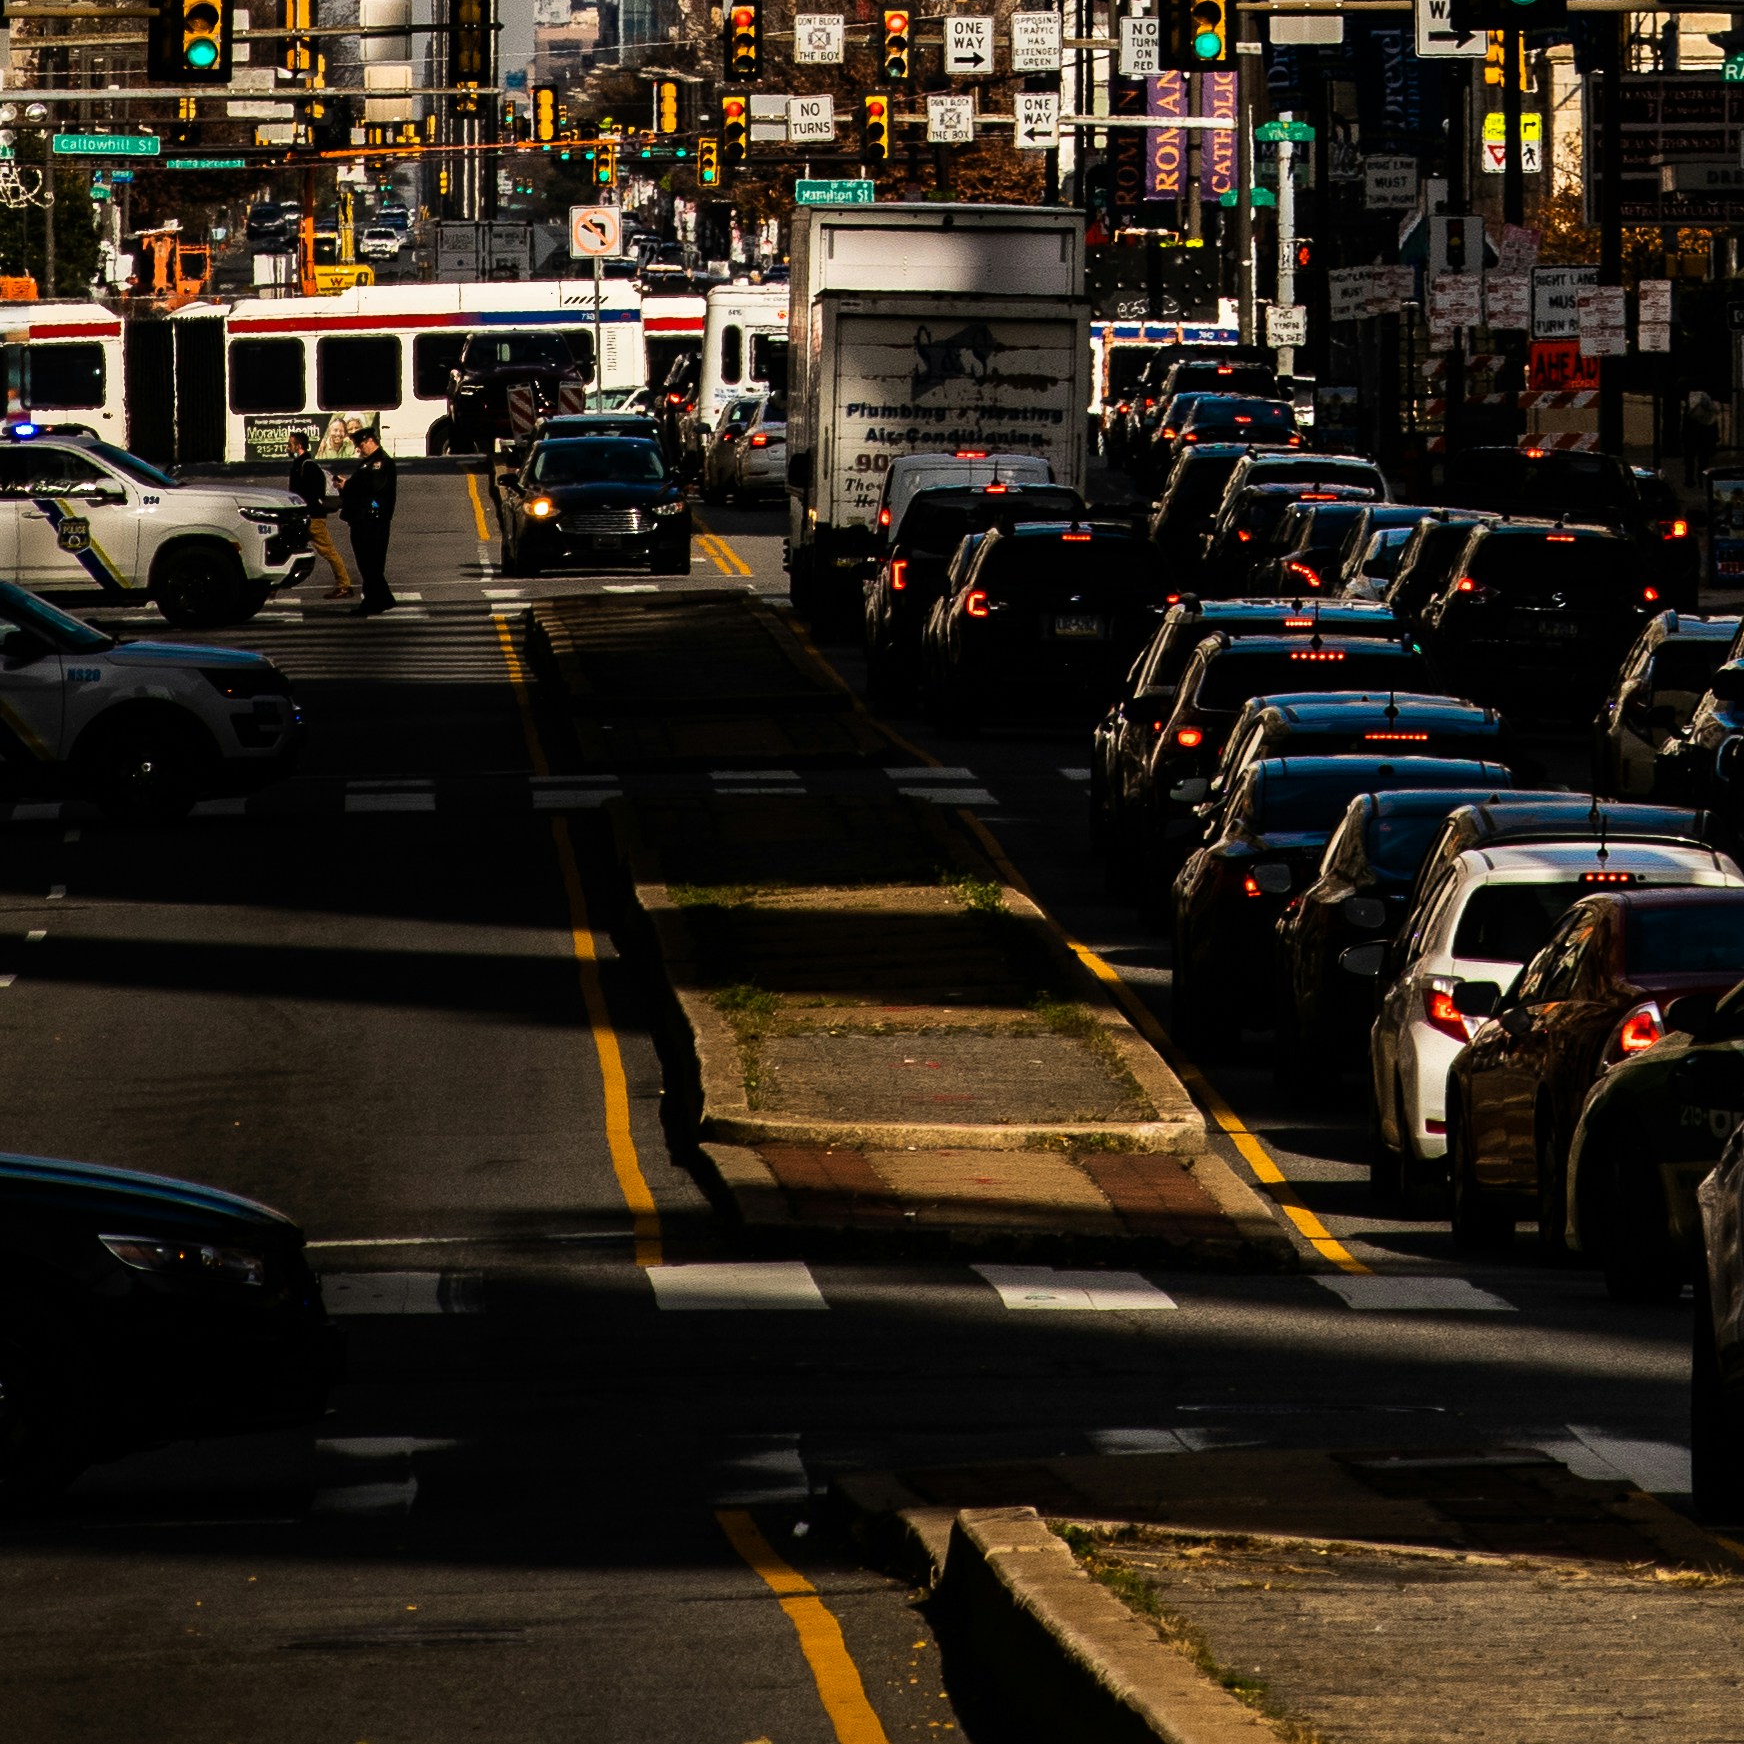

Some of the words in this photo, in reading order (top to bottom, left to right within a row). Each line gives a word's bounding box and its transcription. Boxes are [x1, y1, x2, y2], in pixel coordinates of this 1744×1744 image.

[819, 17, 840, 25] BLOCK
[1015, 16, 1058, 25] OPPOSING
[954, 22, 983, 34] ONE
[1019, 26, 1054, 34] TRAFFIC
[1132, 23, 1157, 35] NO
[954, 37, 985, 49] WAY
[1027, 37, 1046, 45] HAS
[1131, 37, 1159, 47] TURN
[799, 52, 816, 60] THE
[820, 52, 839, 61] BOX
[1015, 47, 1059, 56] EXTENDED
[1136, 49, 1152, 59] ON
[1023, 58, 1051, 67] GREEN
[1133, 60, 1153, 70] RED
[950, 98, 969, 106] BLOCK
[1024, 99, 1051, 110] ONE
[801, 103, 820, 116] NO
[1024, 113, 1051, 124] WAY
[792, 121, 831, 134] TURNS
[932, 130, 949, 139] THE
[952, 130, 969, 139] BOX
[61, 138, 130, 151] Callowhill
[138, 140, 153, 153] St
[1114, 89, 1141, 206] ROMN
[1375, 177, 1407, 188] MUST
[1536, 275, 1566, 286] RIGHT
[1570, 274, 1597, 285] LANE
[1549, 296, 1575, 308] MUS
[1536, 320, 1566, 331] TURN
[1534, 353, 1598, 381] AHEAD
[846, 403, 946, 421] Plumbing
[980, 404, 1063, 423] Heating
[865, 428, 1044, 446] Air-Conditioning
[143, 496, 160, 505] 934
[62, 525, 86, 534] POLICE
